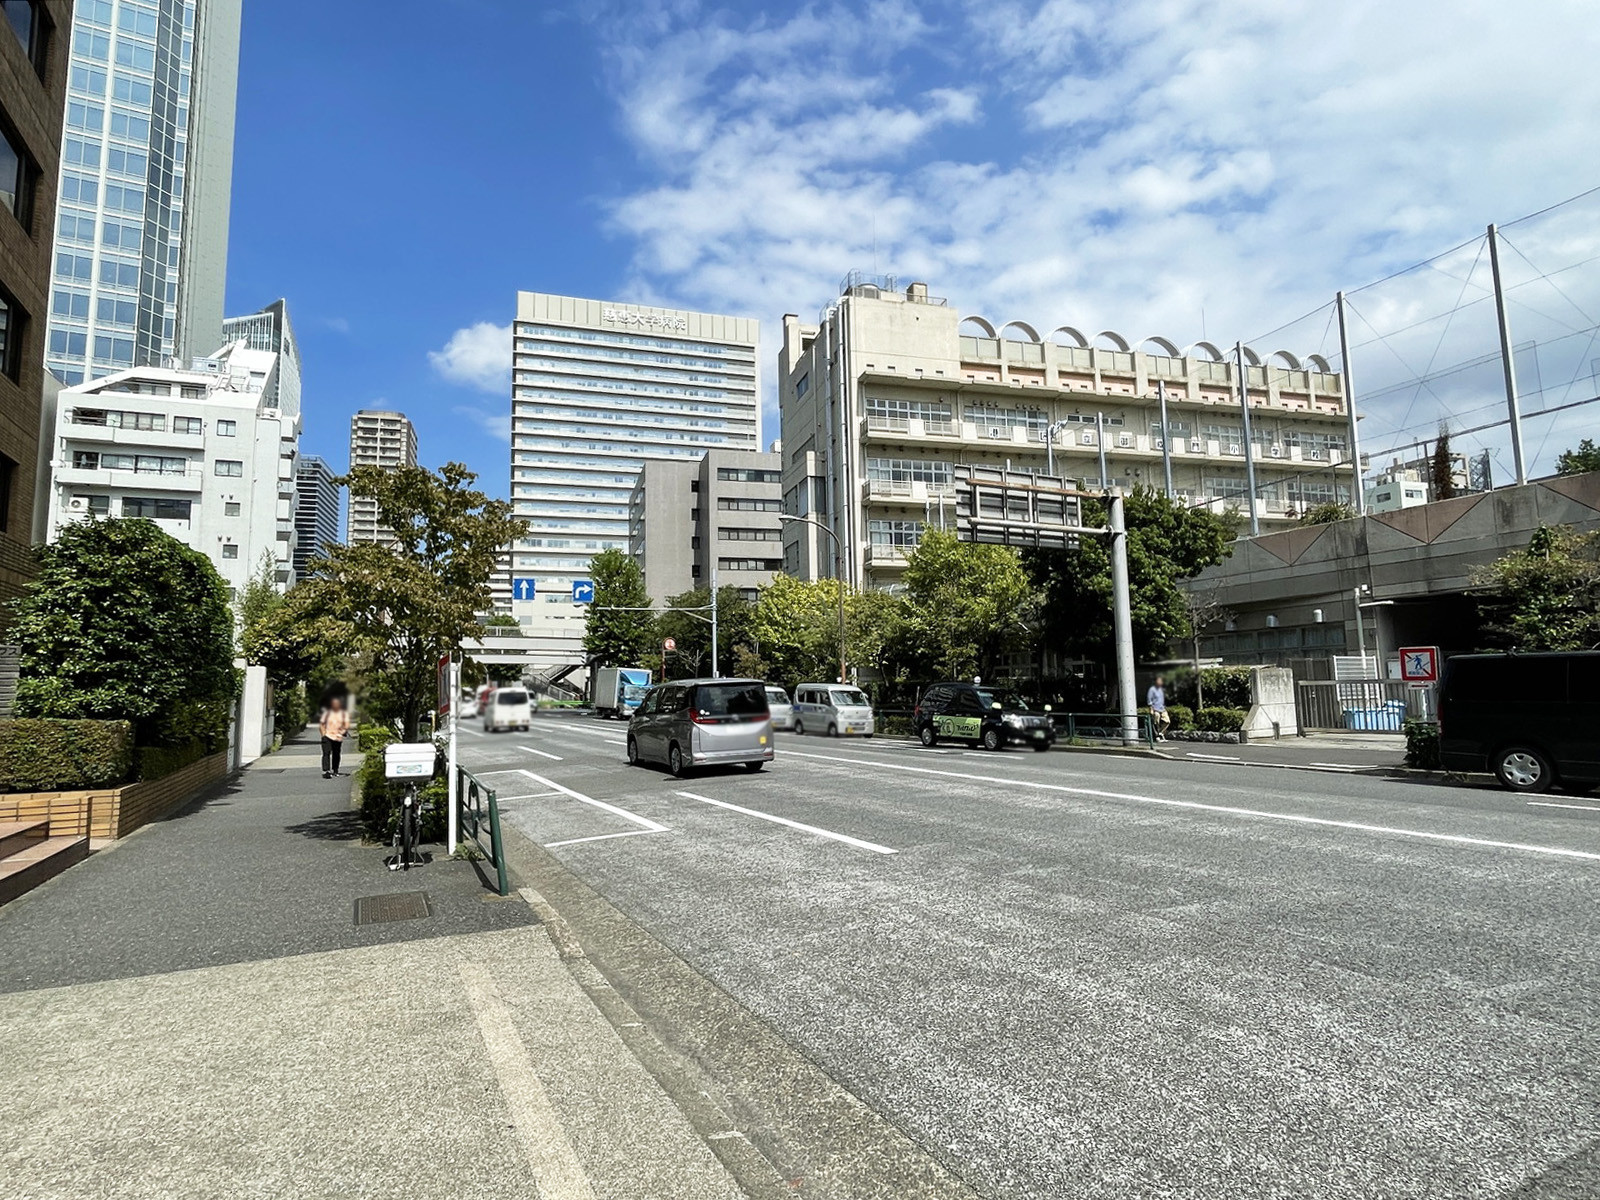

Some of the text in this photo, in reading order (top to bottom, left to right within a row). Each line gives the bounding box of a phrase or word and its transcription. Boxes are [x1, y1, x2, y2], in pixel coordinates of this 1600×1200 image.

[603, 307, 686, 331] 慈恵大学病院
